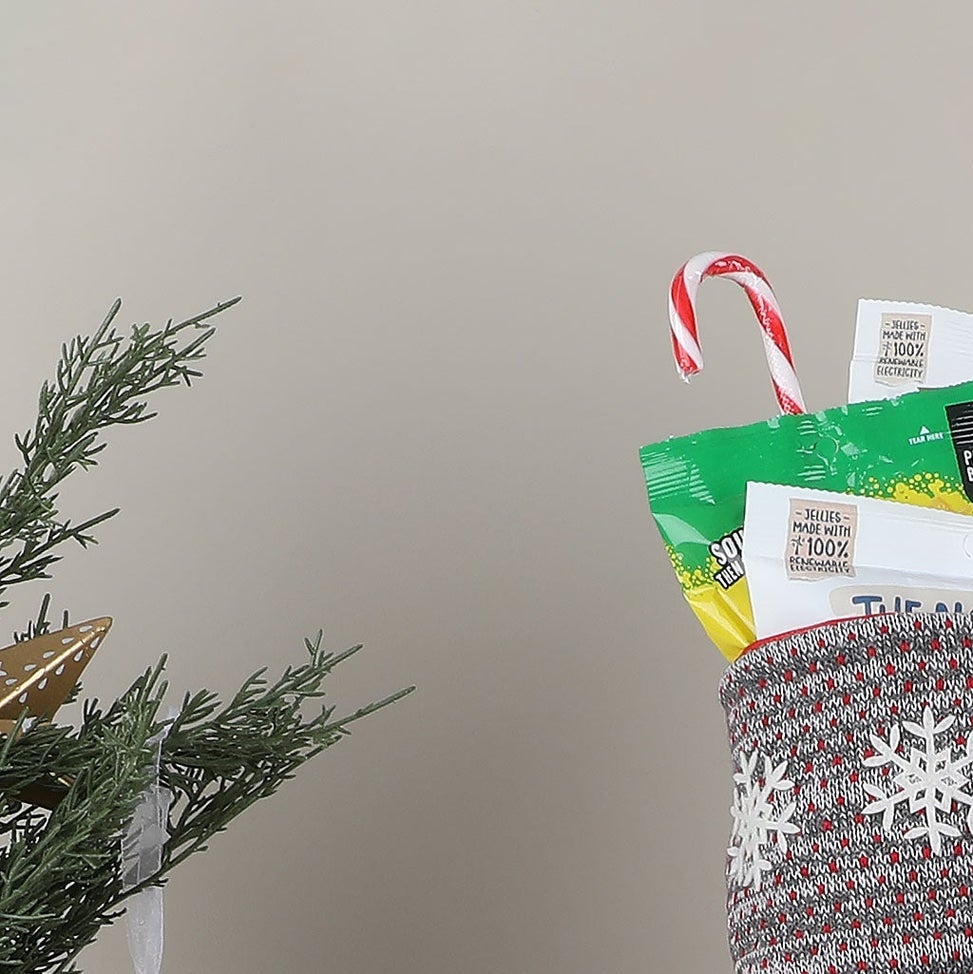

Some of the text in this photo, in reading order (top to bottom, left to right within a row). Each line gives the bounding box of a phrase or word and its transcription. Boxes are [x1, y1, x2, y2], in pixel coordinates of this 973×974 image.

[891, 319, 920, 331] JELLIES
[882, 330, 926, 342] MADE WITH
[893, 341, 925, 358] 100%
[876, 365, 924, 378] ELECTRICITY
[804, 508, 842, 523] JELLIES
[792, 520, 851, 538] MADE WITH
[807, 536, 850, 558] 100%
[714, 559, 745, 589] THEN
